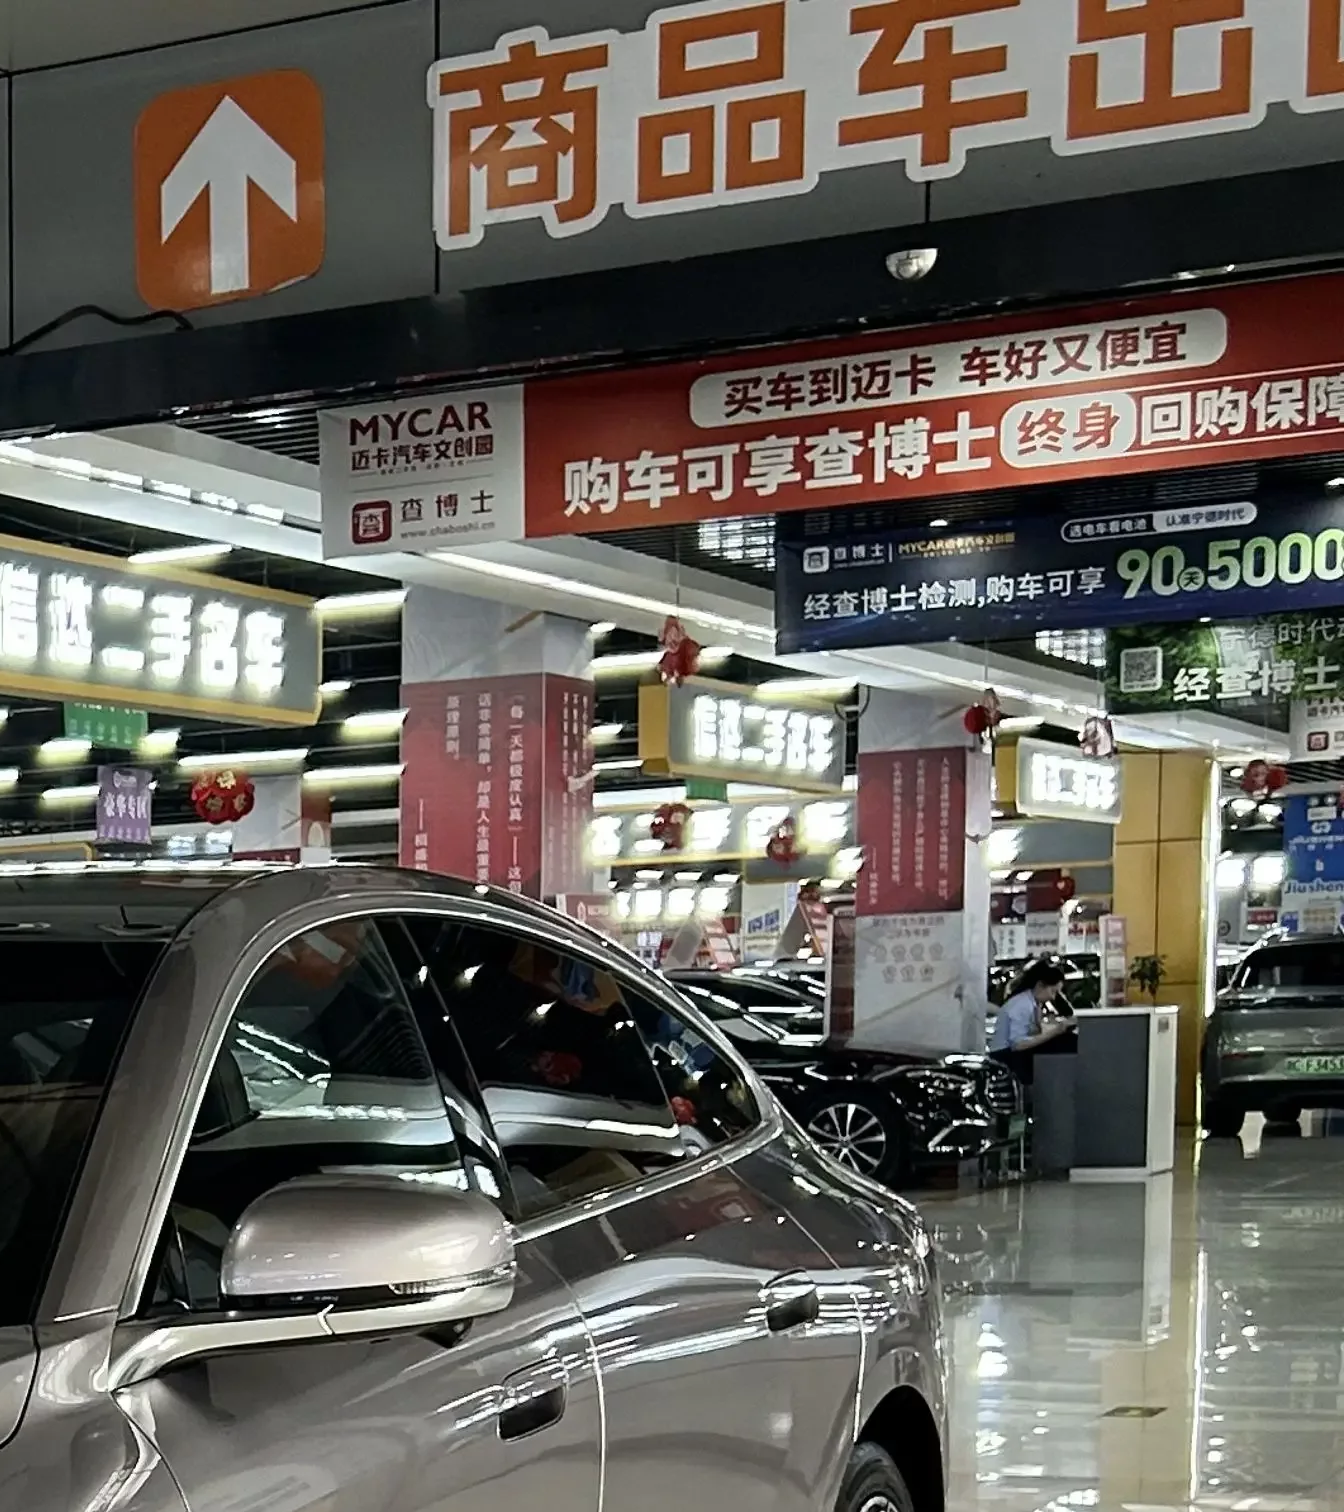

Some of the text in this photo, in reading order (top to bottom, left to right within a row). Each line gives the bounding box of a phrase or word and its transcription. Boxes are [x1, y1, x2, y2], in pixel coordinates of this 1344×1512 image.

[434, 0, 1344, 242] 商品车出
[723, 320, 1188, 418] 买车到迈卡 车好又便宜
[349, 401, 492, 446] MYCAR
[351, 434, 494, 471] 迈卡汽车文创园
[563, 410, 996, 518] 购车可享查博士
[1015, 400, 1120, 457] 终身
[400, 490, 495, 523] 查博士
